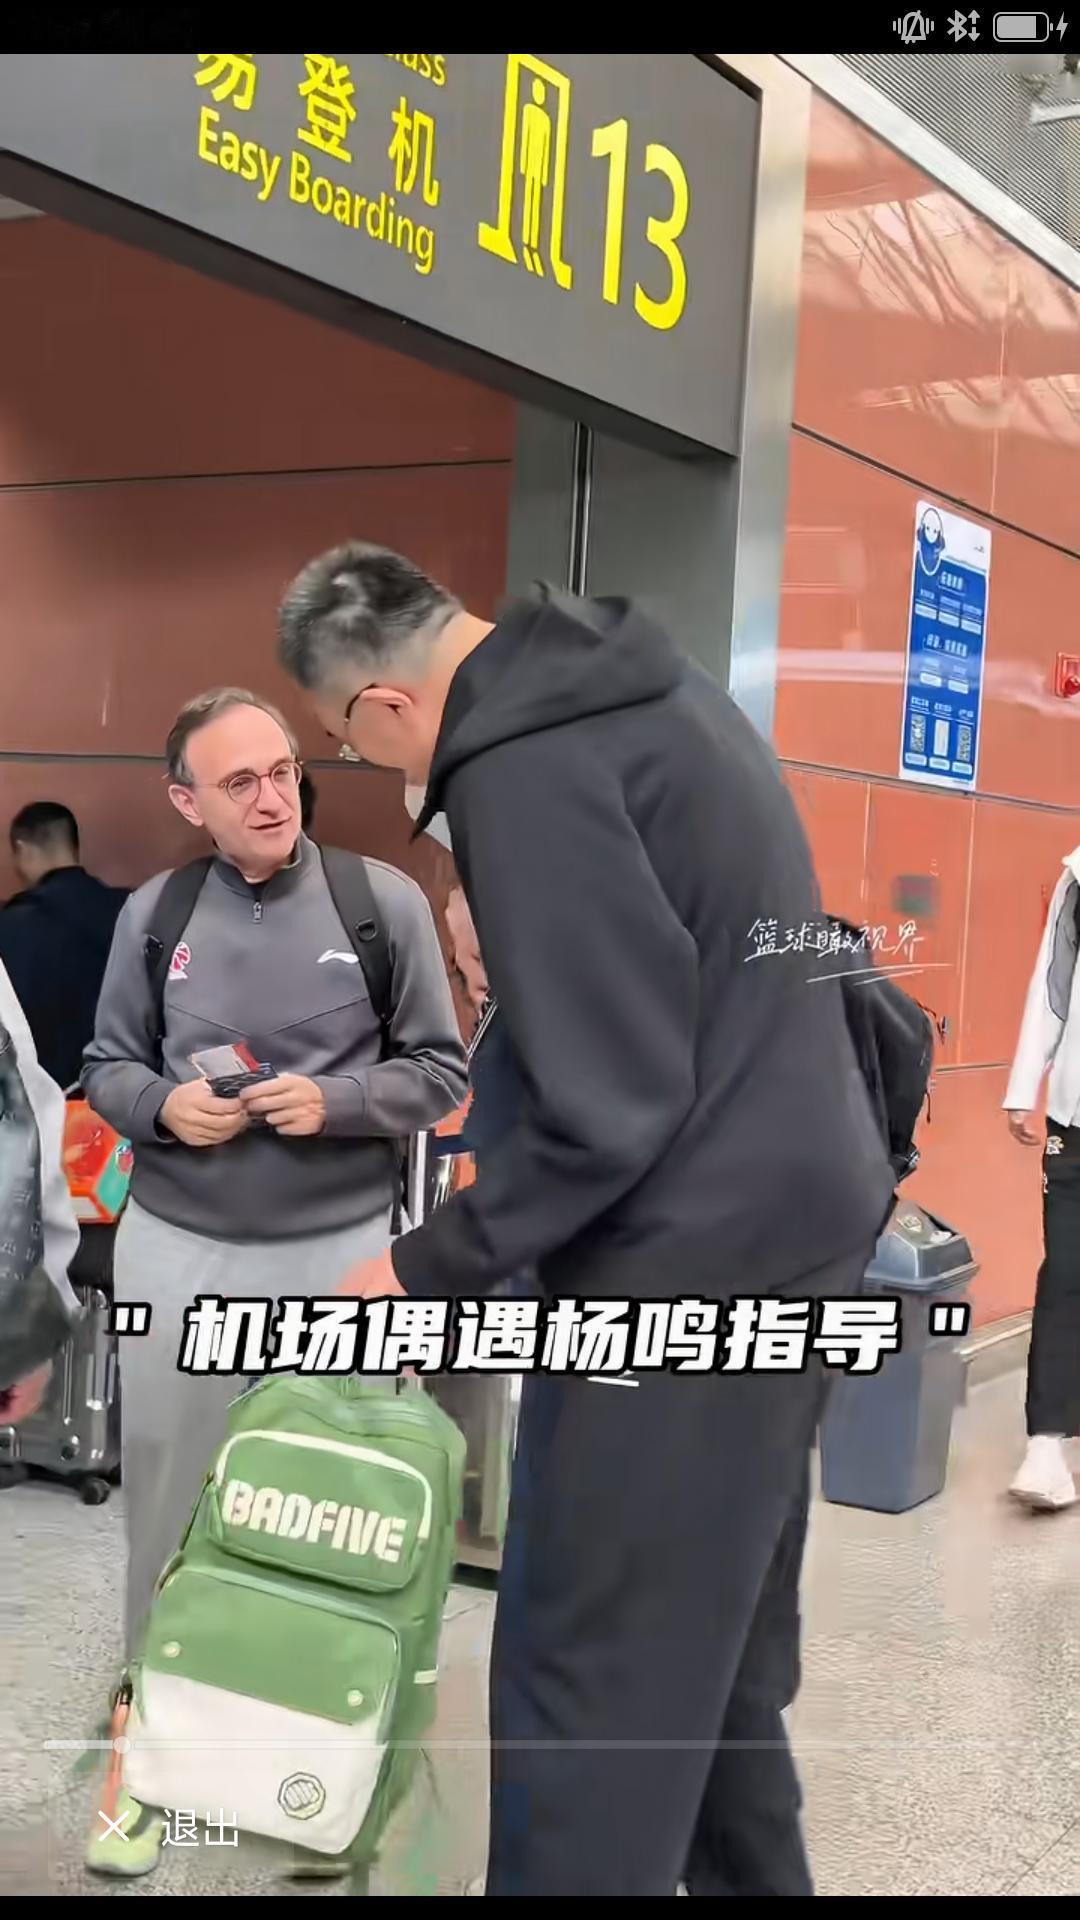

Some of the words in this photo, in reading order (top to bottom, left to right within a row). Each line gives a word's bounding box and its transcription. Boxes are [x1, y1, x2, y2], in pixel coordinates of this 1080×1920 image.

[384, 54, 446, 86] ass
[198, 105, 282, 202] Easy
[288, 149, 436, 276] Boarding
[592, 117, 690, 332] 13
[221, 1478, 408, 1563] BADFIVE
